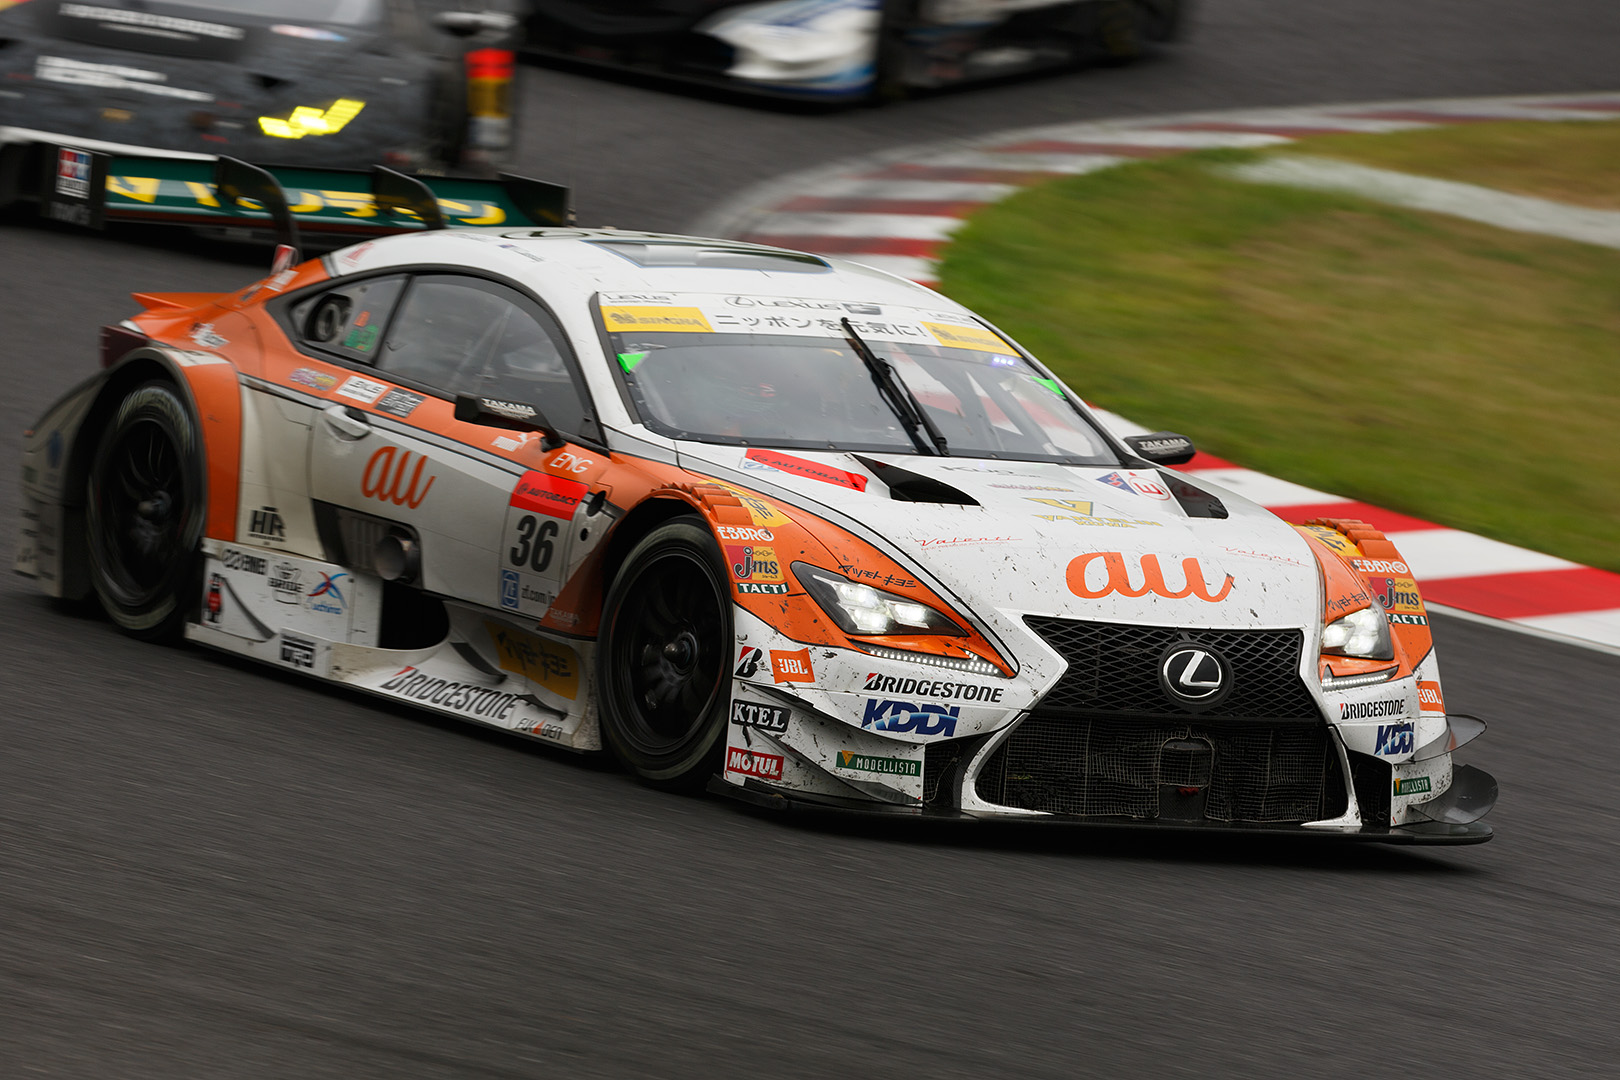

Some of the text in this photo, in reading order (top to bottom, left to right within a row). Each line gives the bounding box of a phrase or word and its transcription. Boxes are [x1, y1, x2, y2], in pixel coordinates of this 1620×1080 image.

[550, 452, 593, 473] ENG
[360, 445, 436, 510] au
[527, 488, 578, 506] AUTOBACS
[510, 515, 558, 572] 36
[717, 526, 774, 542] EBBRO
[733, 546, 779, 579] jms
[740, 583, 787, 594] TACTI
[1066, 552, 1235, 603] au
[1327, 592, 1366, 612] マツモトキヨ
[1379, 578, 1419, 609] jms
[779, 658, 808, 675] JBL
[379, 666, 516, 720] BRIDGESTONE
[863, 672, 1005, 703] BRIDGESTONE
[1420, 689, 1442, 705] JBL
[733, 702, 785, 729] KTEL
[861, 698, 961, 737] KDDI
[1340, 699, 1405, 720] BRIDGESTONE
[1374, 722, 1415, 755] KDDI
[729, 751, 780, 776] MOTUL
[856, 757, 916, 774] MODELLISTA
